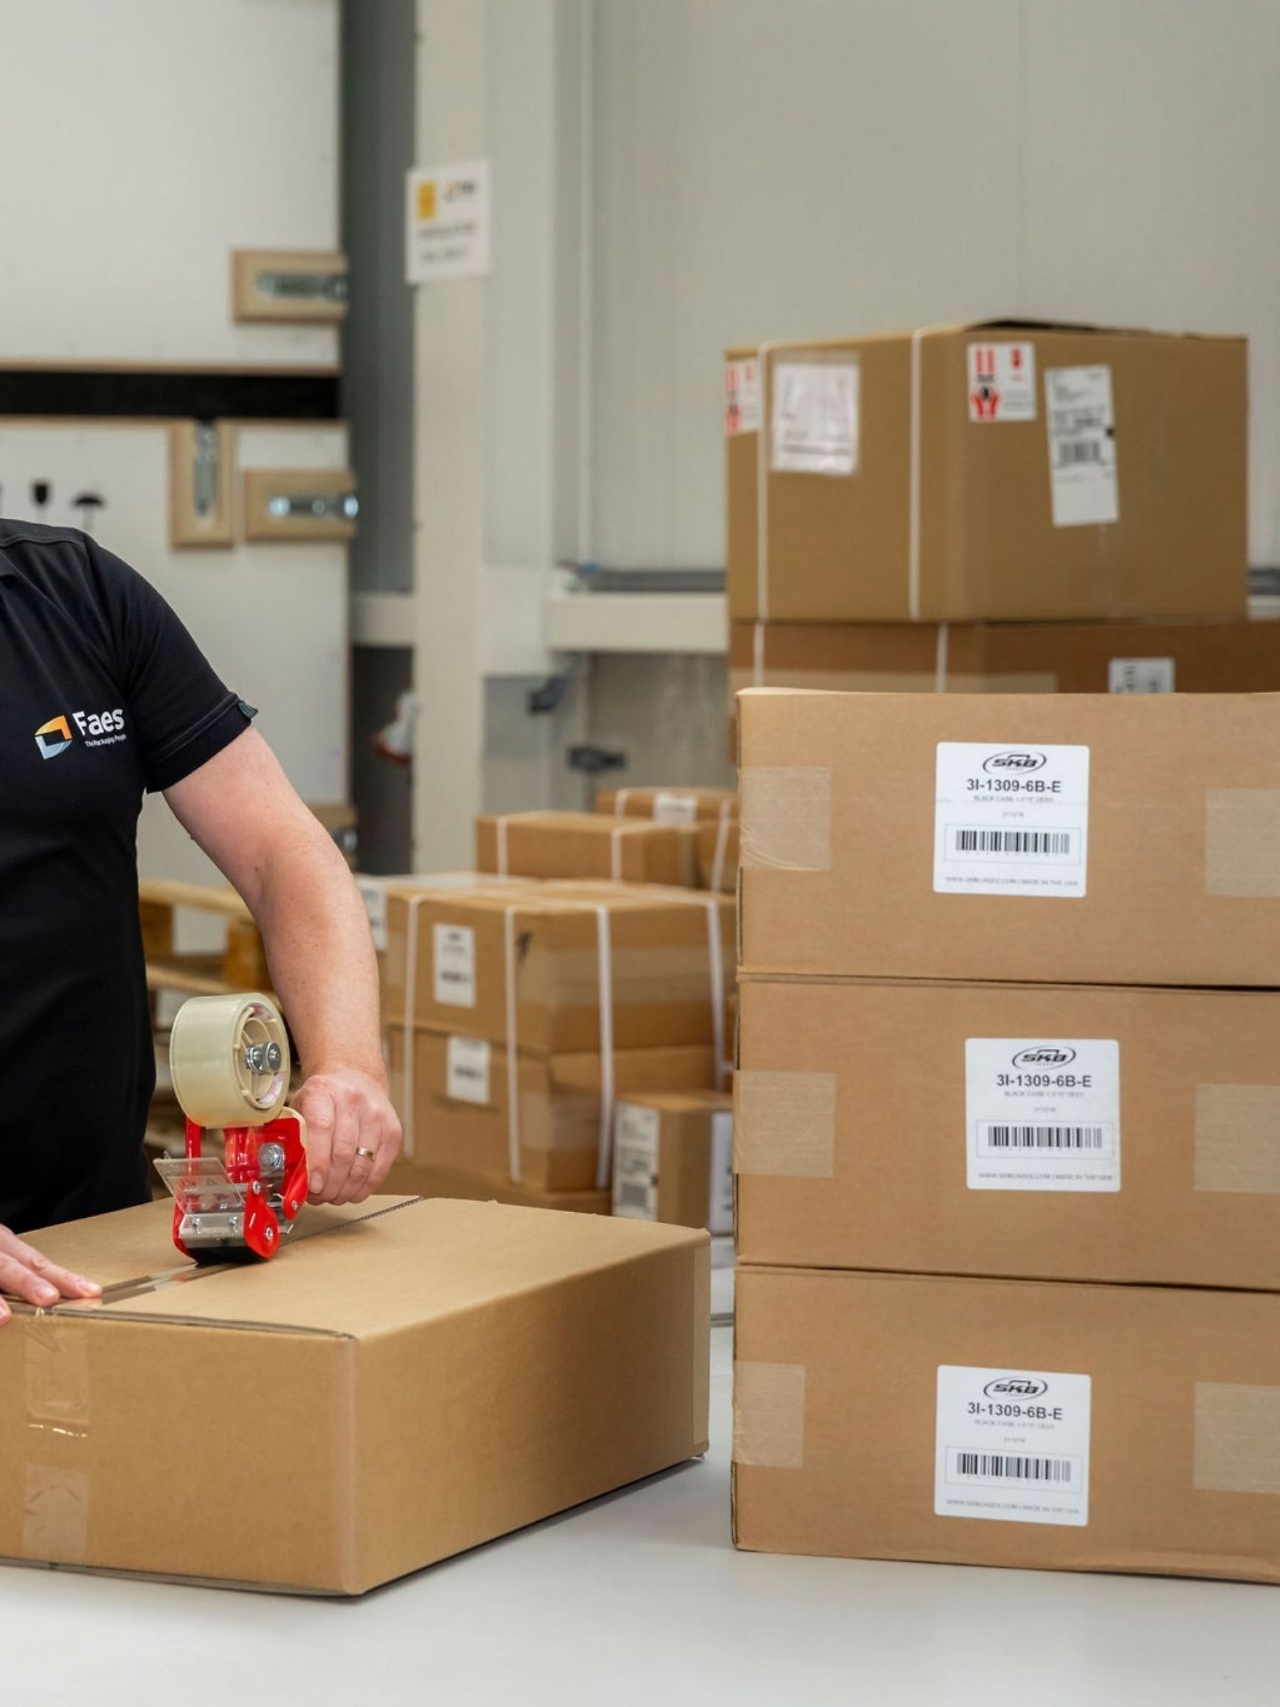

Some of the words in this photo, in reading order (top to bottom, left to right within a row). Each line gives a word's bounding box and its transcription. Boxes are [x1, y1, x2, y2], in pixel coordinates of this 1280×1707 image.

[72, 708, 125, 736] Faes
[992, 755, 1038, 768] SKB
[966, 778, 1062, 793] 3I-1309-6B-E
[1022, 1049, 1067, 1062] SKB
[996, 1074, 1092, 1088] 3I-1309-6B-E
[993, 1380, 1039, 1394] SKB
[967, 1402, 1063, 1420] 3I-1309-6B-E
